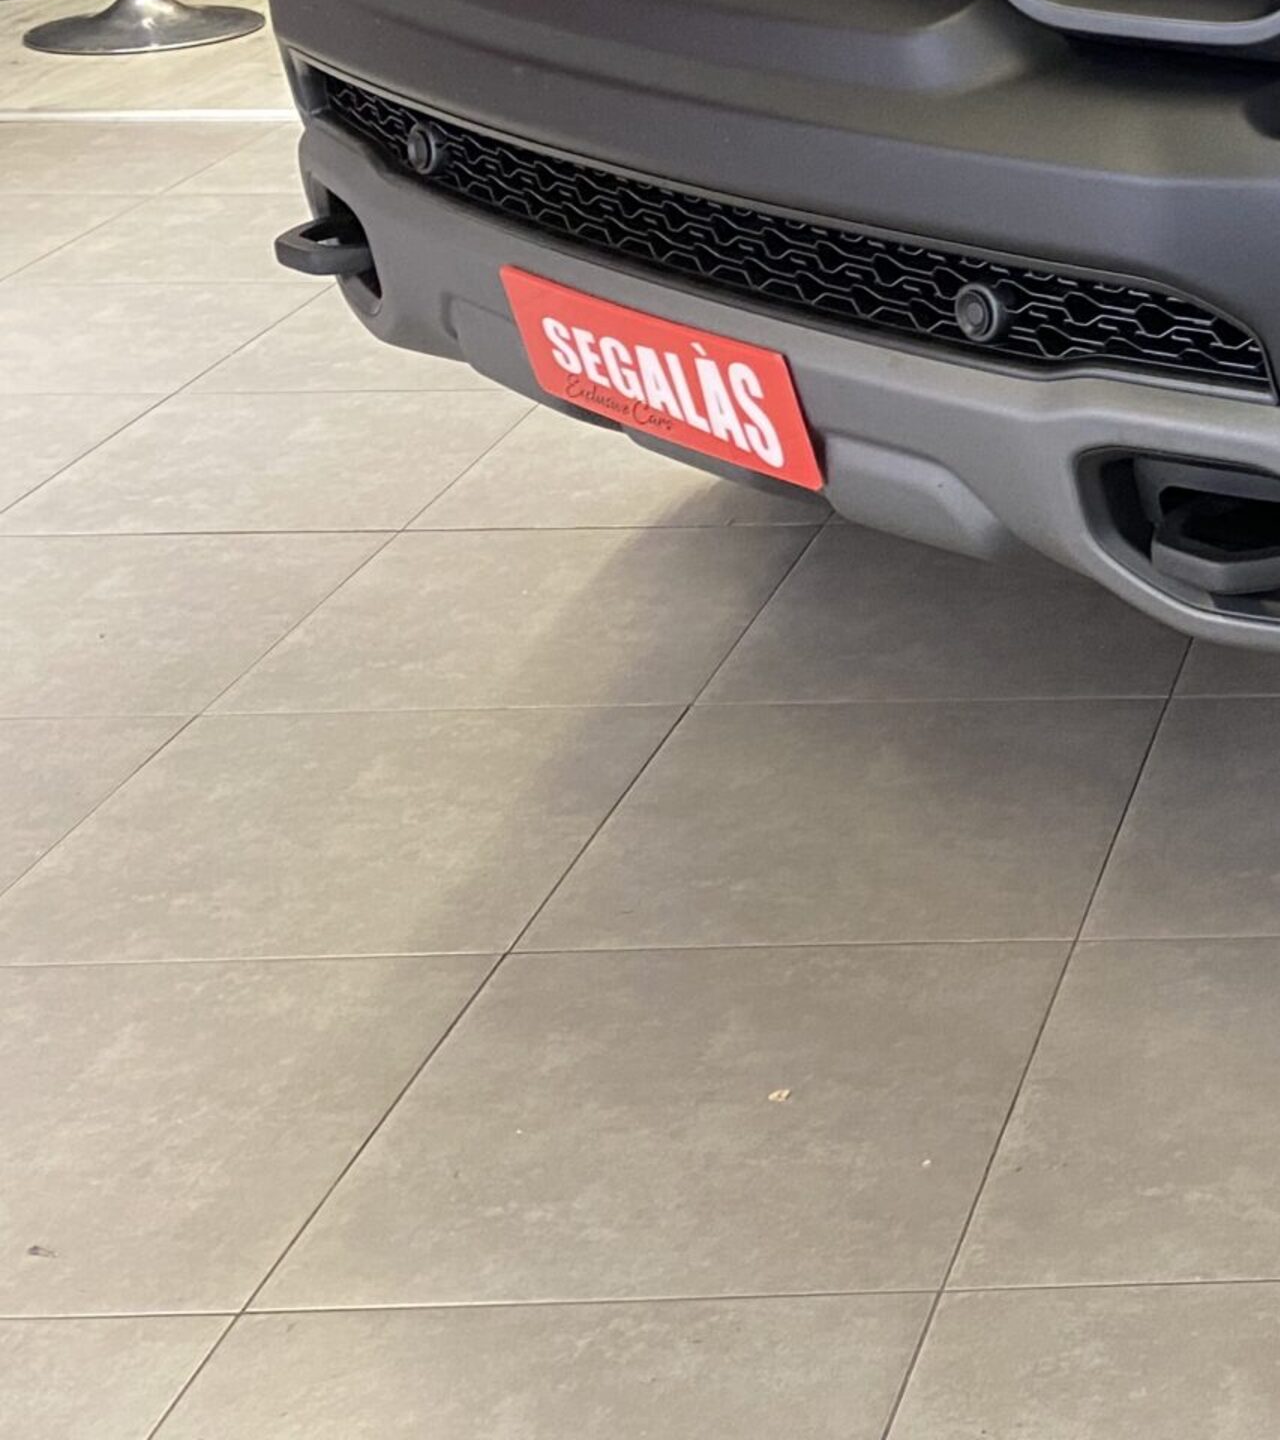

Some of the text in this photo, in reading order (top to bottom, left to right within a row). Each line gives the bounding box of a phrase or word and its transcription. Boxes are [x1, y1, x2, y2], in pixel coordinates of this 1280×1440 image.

[542, 317, 785, 469] SEGALÀS
[564, 374, 674, 433] Exclusive Cars
